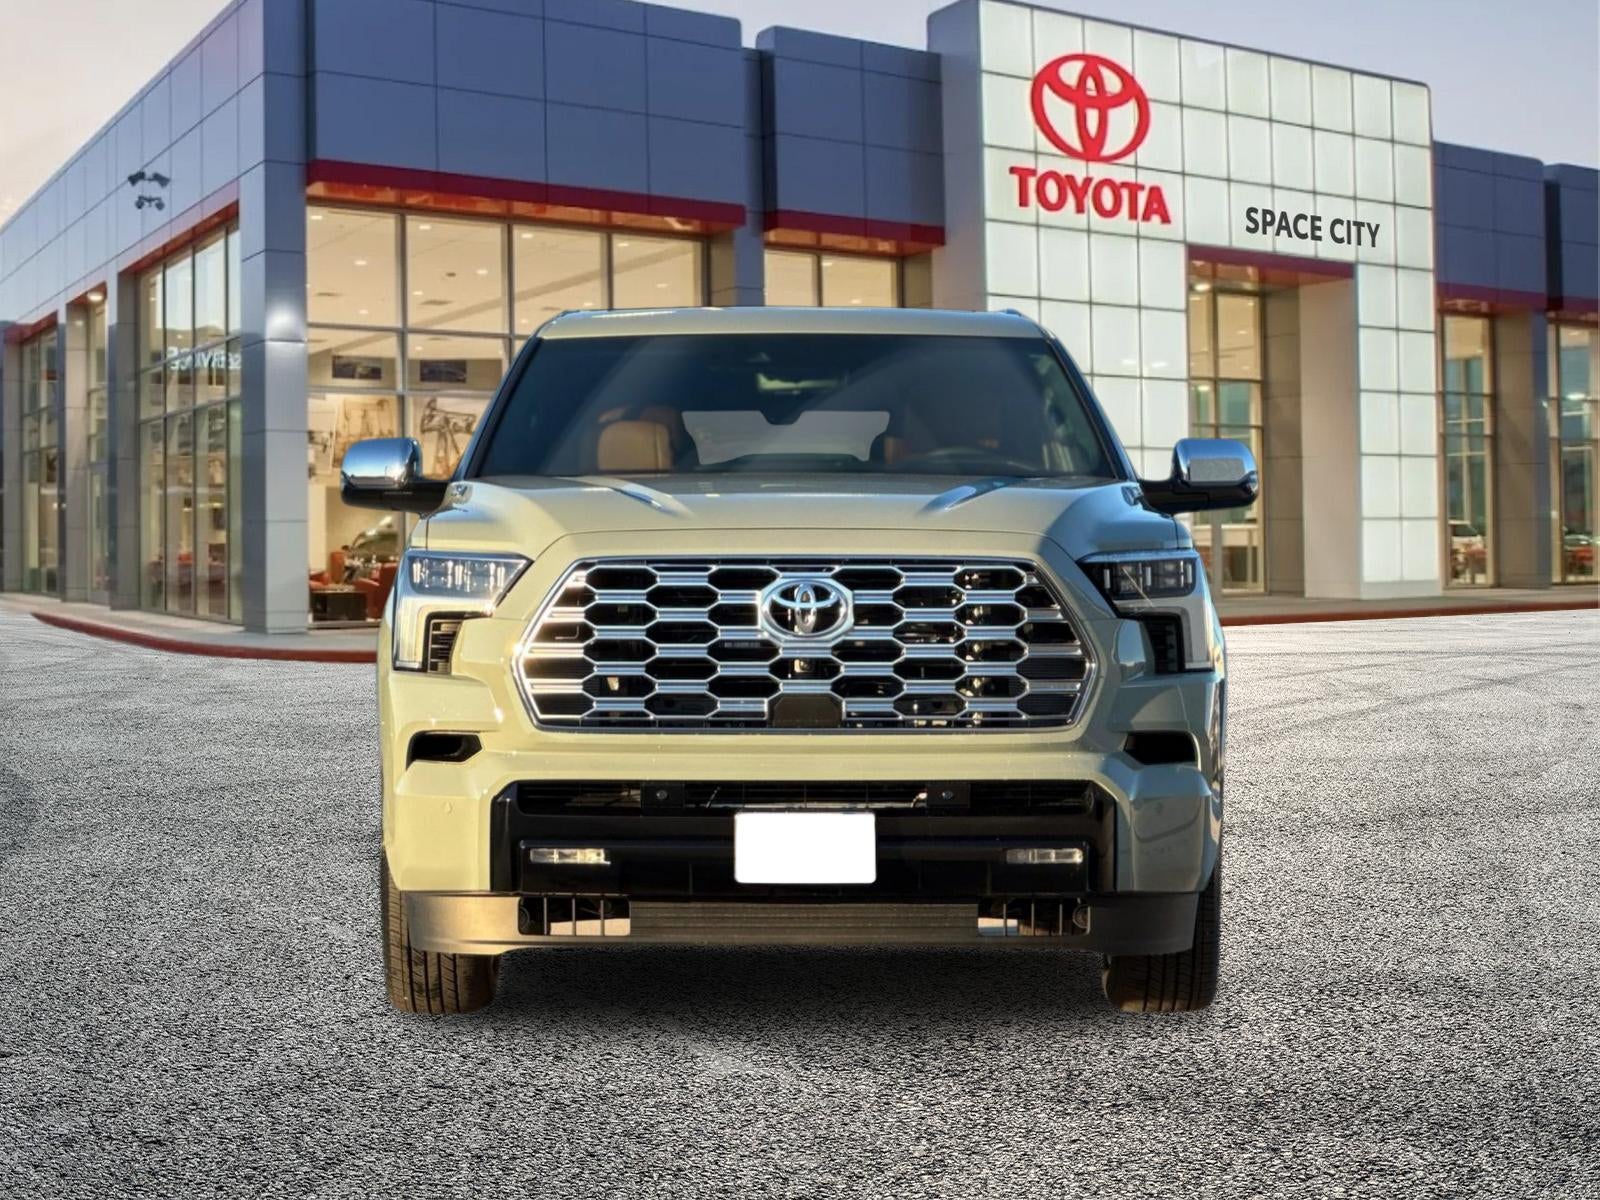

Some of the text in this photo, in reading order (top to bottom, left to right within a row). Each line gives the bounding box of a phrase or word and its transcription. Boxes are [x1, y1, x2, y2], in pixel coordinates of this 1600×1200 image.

[1009, 166, 1171, 224] TOYOTA
[1245, 206, 1381, 248] SPACE CITY
